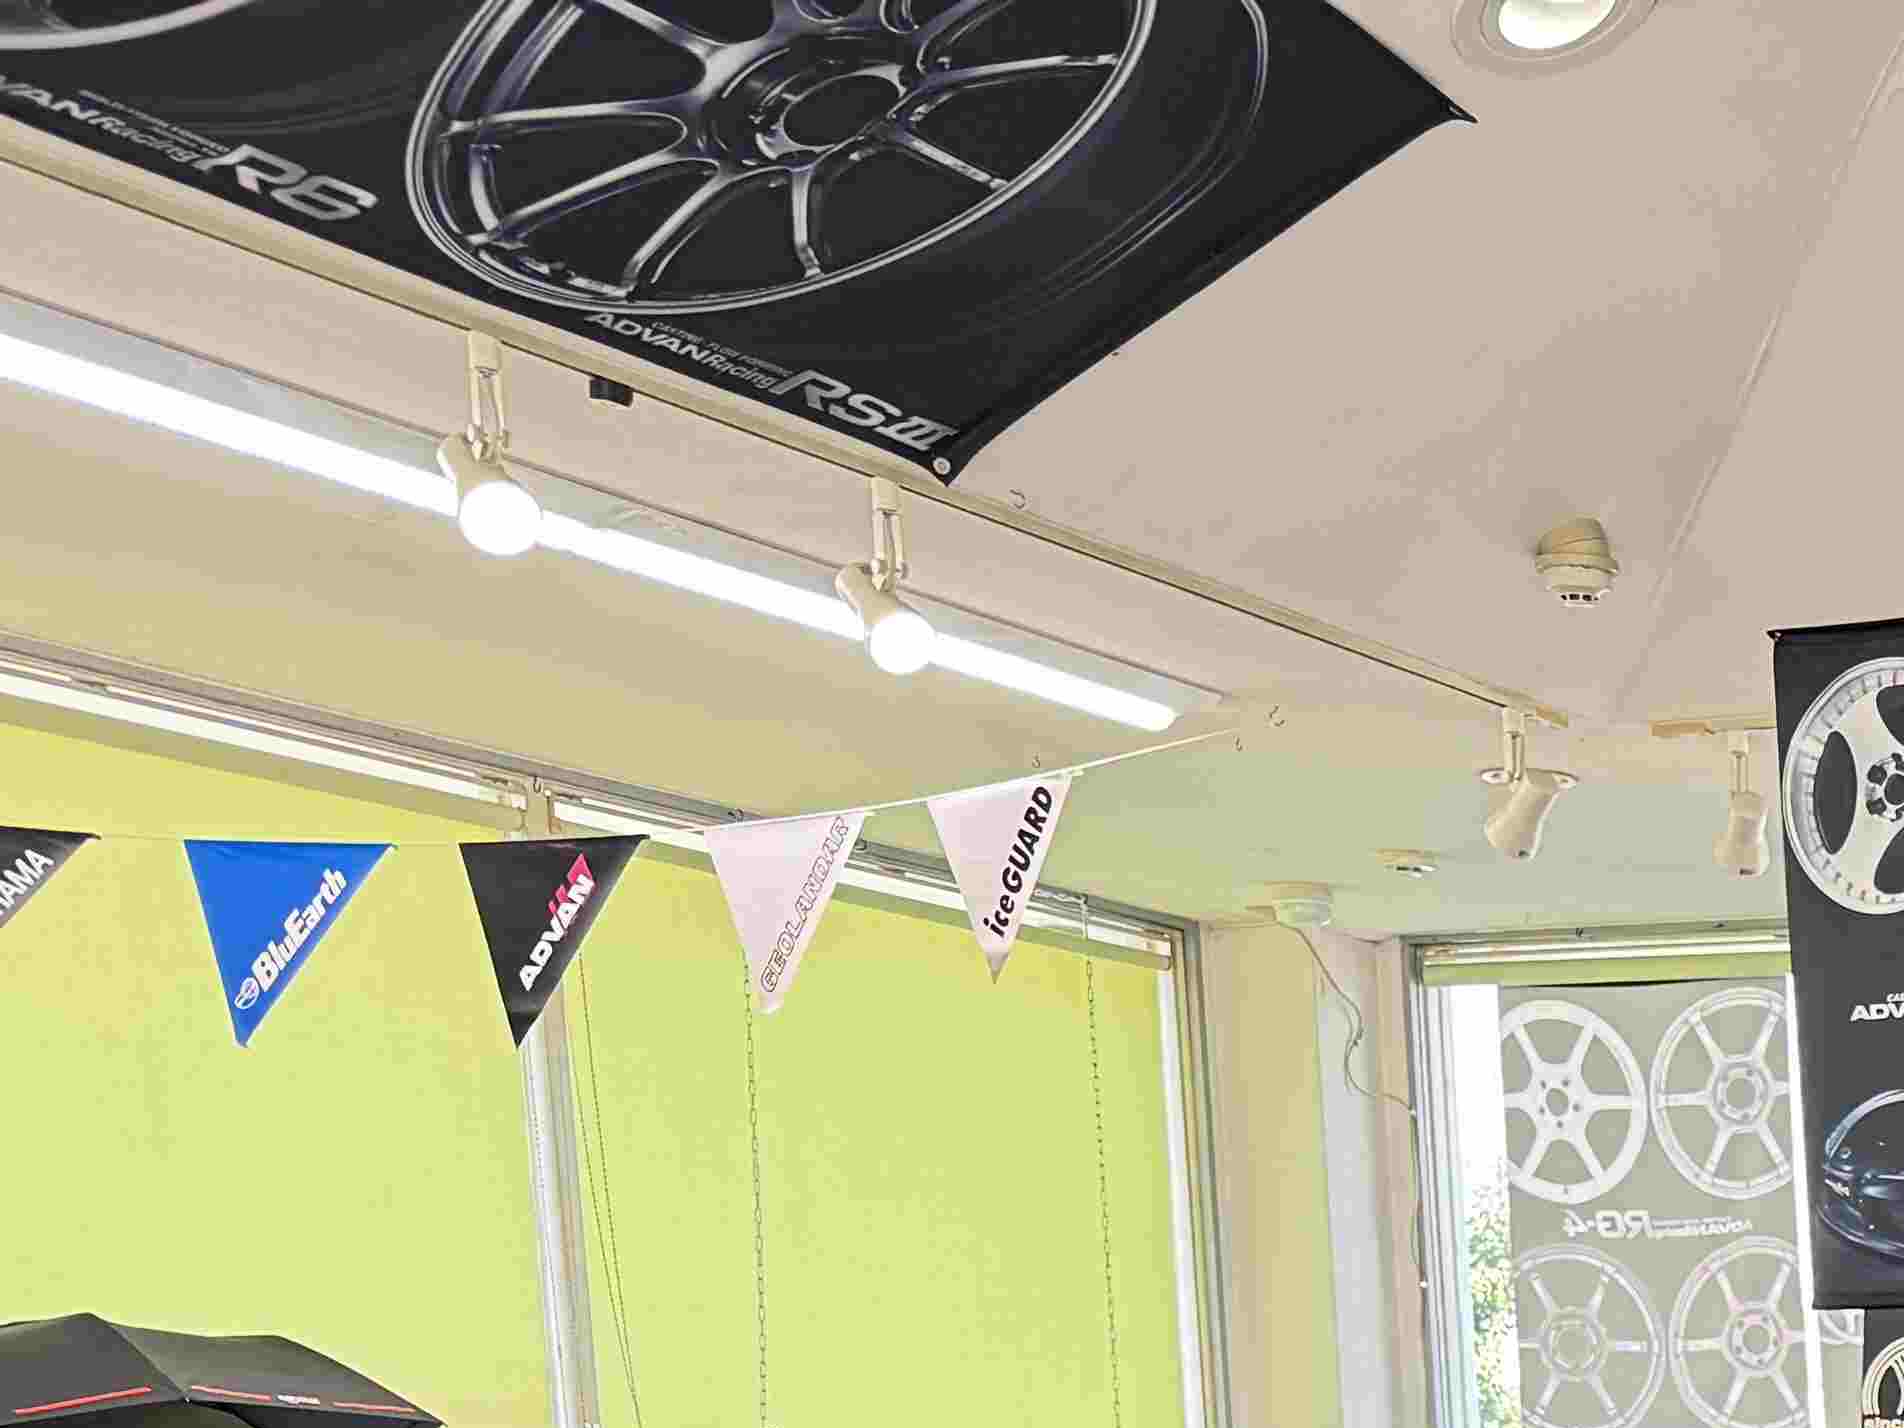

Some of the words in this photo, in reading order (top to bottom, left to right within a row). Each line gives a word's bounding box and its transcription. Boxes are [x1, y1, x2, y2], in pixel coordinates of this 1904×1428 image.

[251, 868, 347, 991] BluEarth
[760, 816, 849, 994] GEOLANDAR
[982, 785, 1054, 939] iceGUARD
[517, 873, 597, 991] ADVAN
